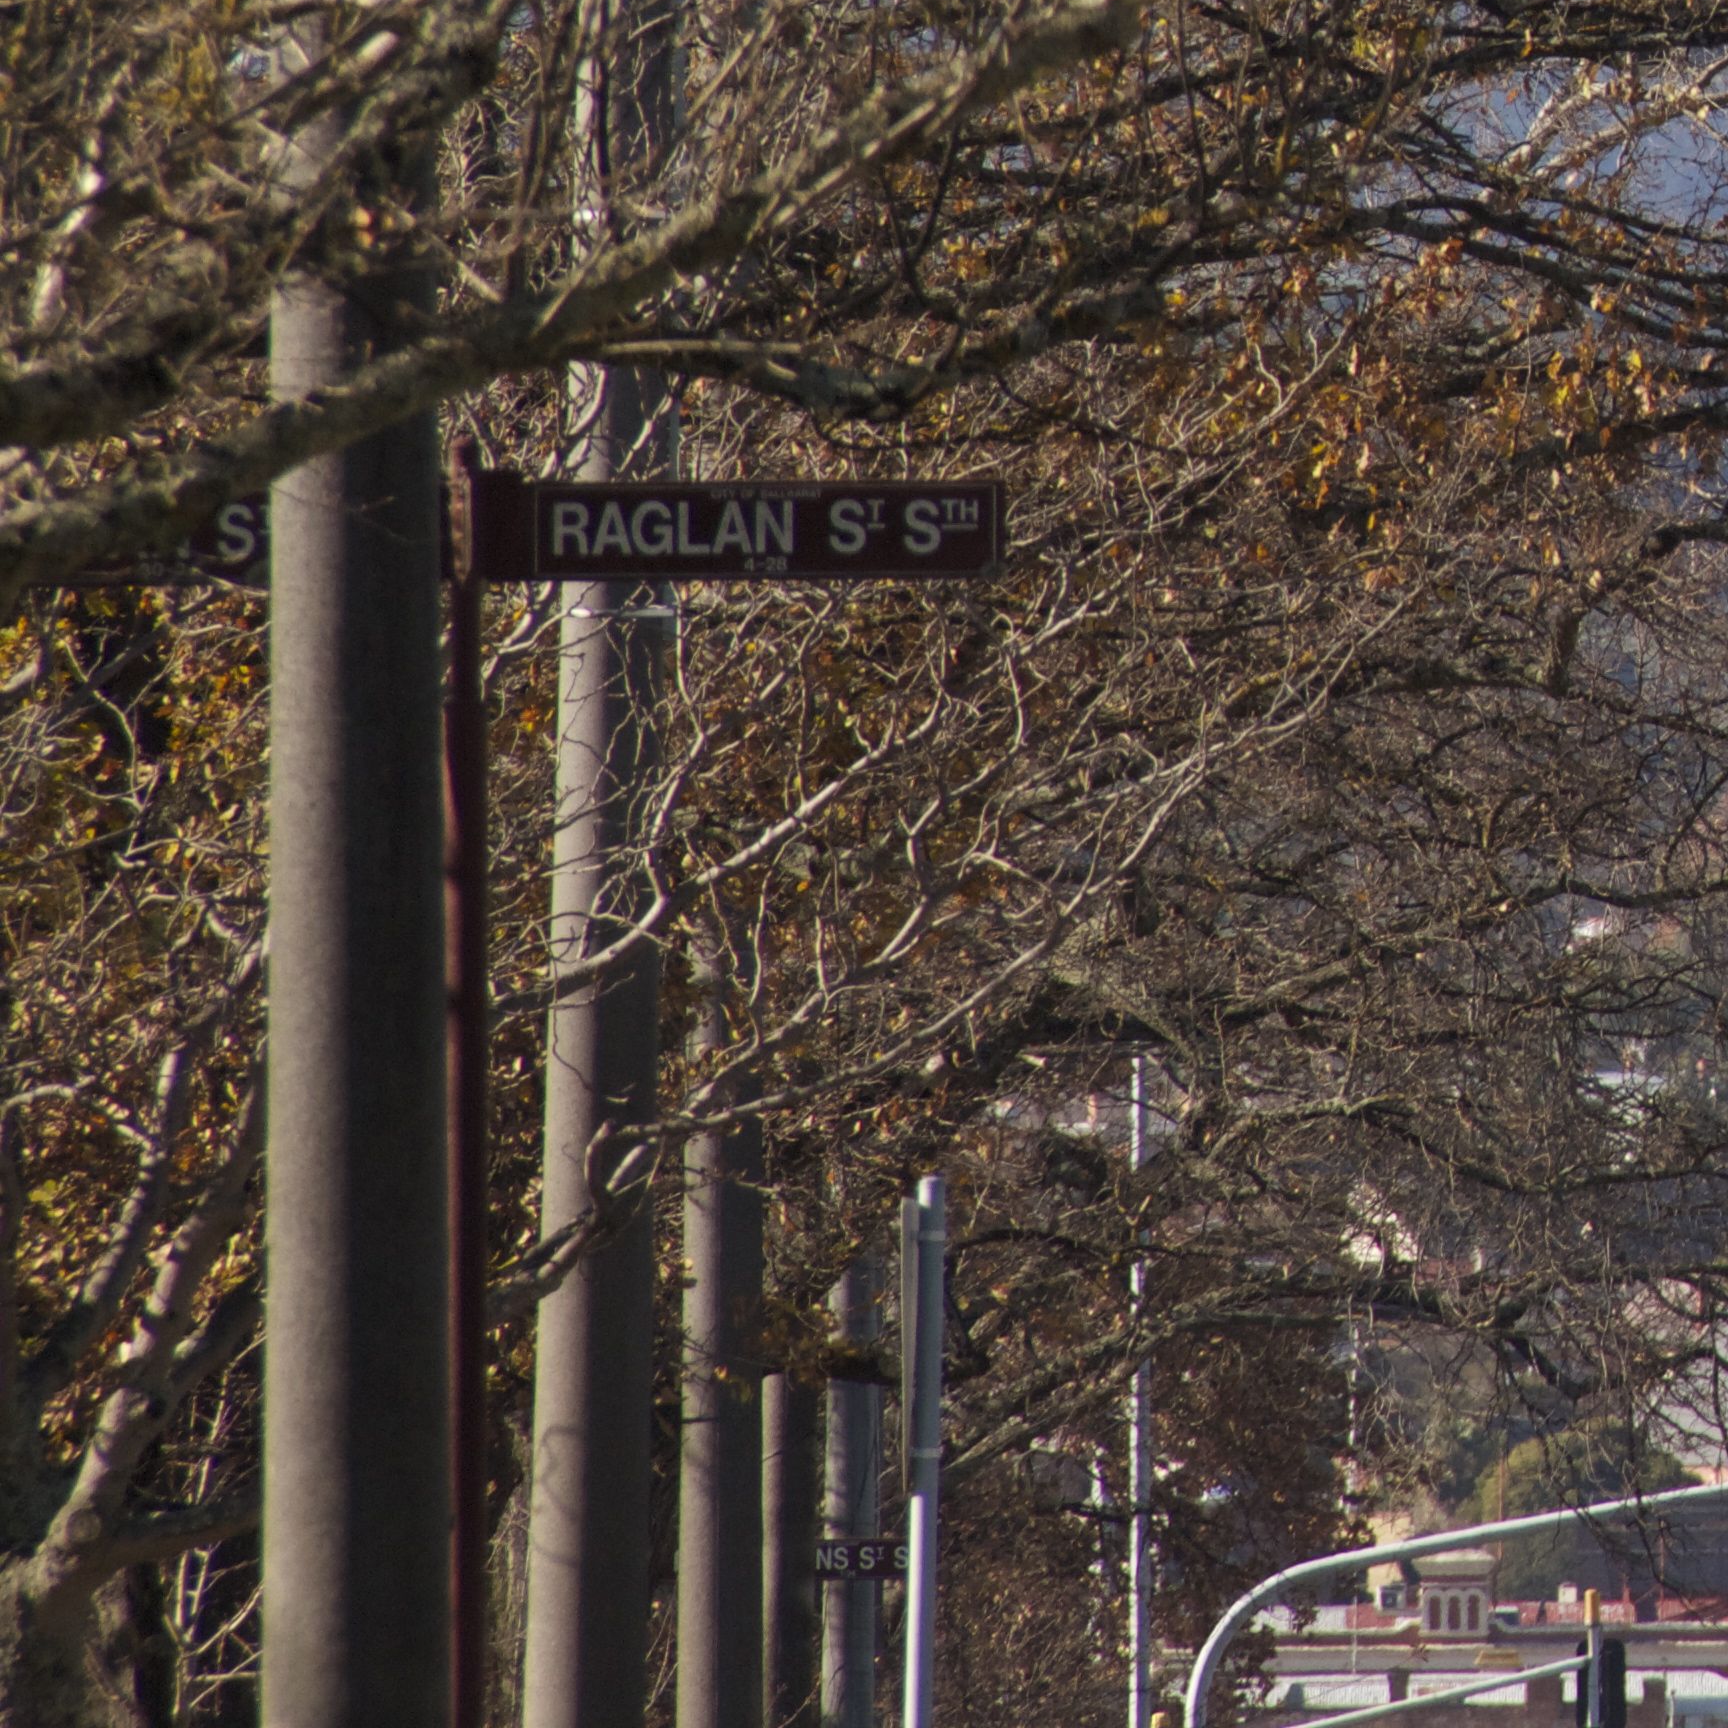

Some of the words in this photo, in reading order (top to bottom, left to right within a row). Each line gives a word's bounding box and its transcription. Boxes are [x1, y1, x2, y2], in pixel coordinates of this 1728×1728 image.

[552, 500, 795, 556] RAGLAN
[828, 498, 886, 555] ST
[903, 498, 979, 555] STH
